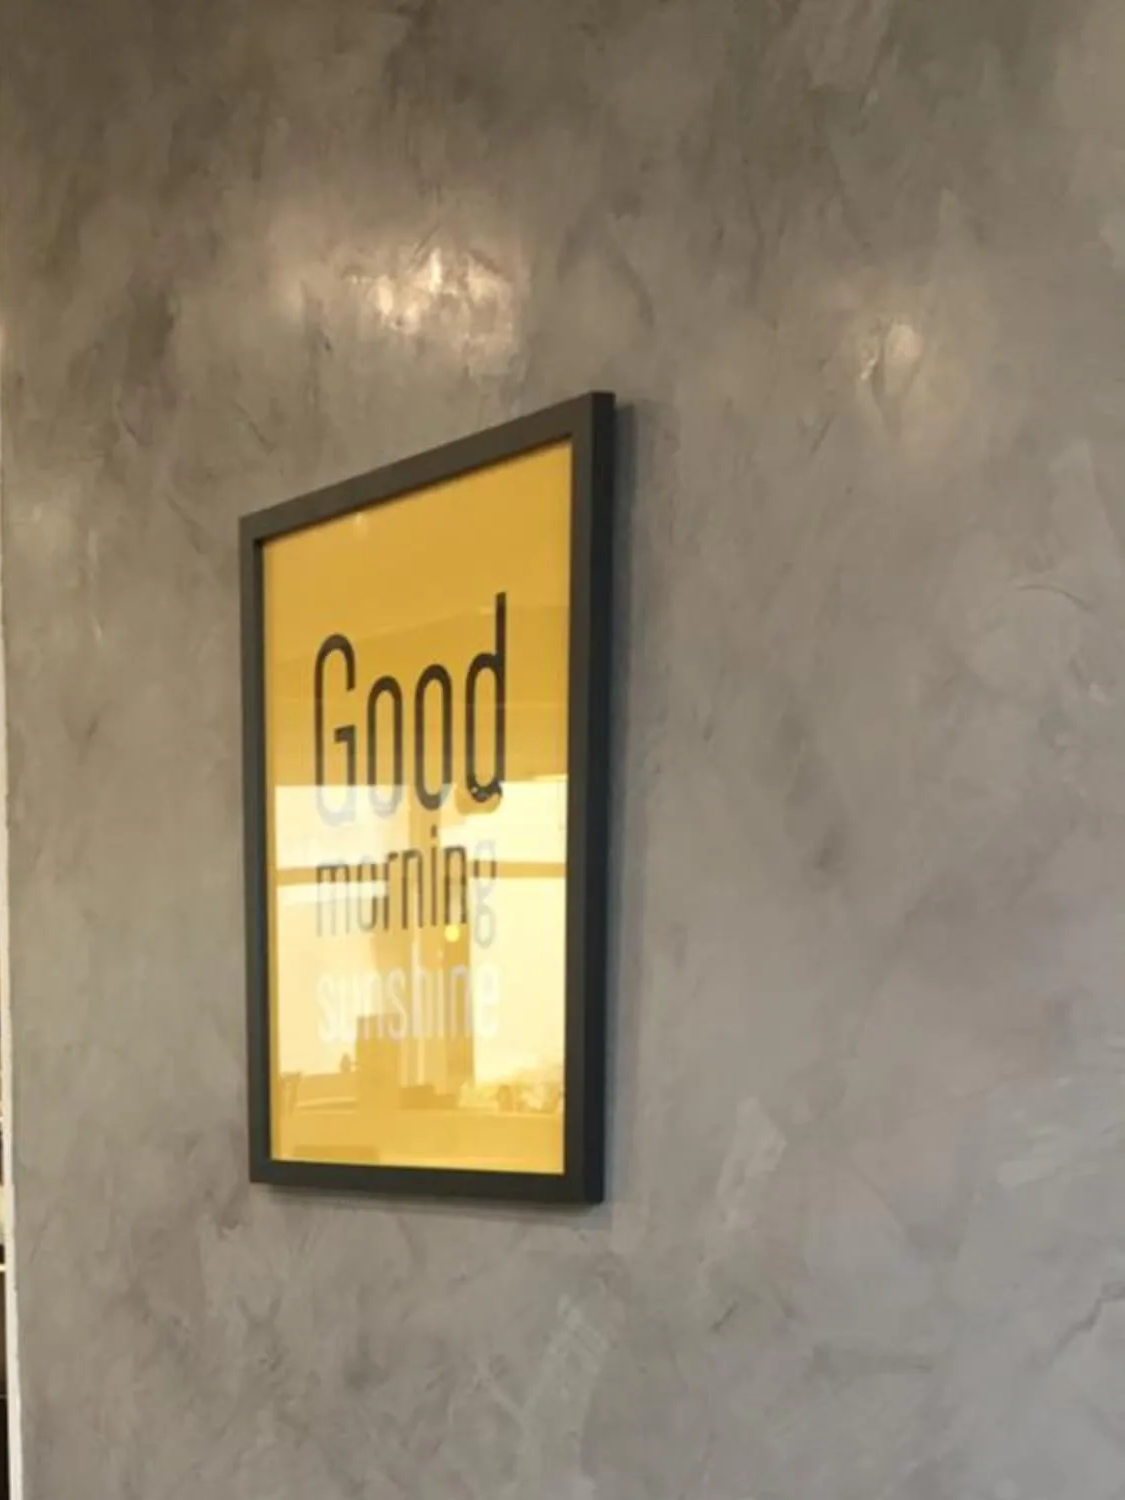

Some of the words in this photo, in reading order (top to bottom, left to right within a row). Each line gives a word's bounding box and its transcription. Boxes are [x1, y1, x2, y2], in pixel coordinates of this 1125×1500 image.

[314, 591, 507, 826] Good
[315, 824, 497, 948] morning
[315, 963, 500, 1044] sunshine
